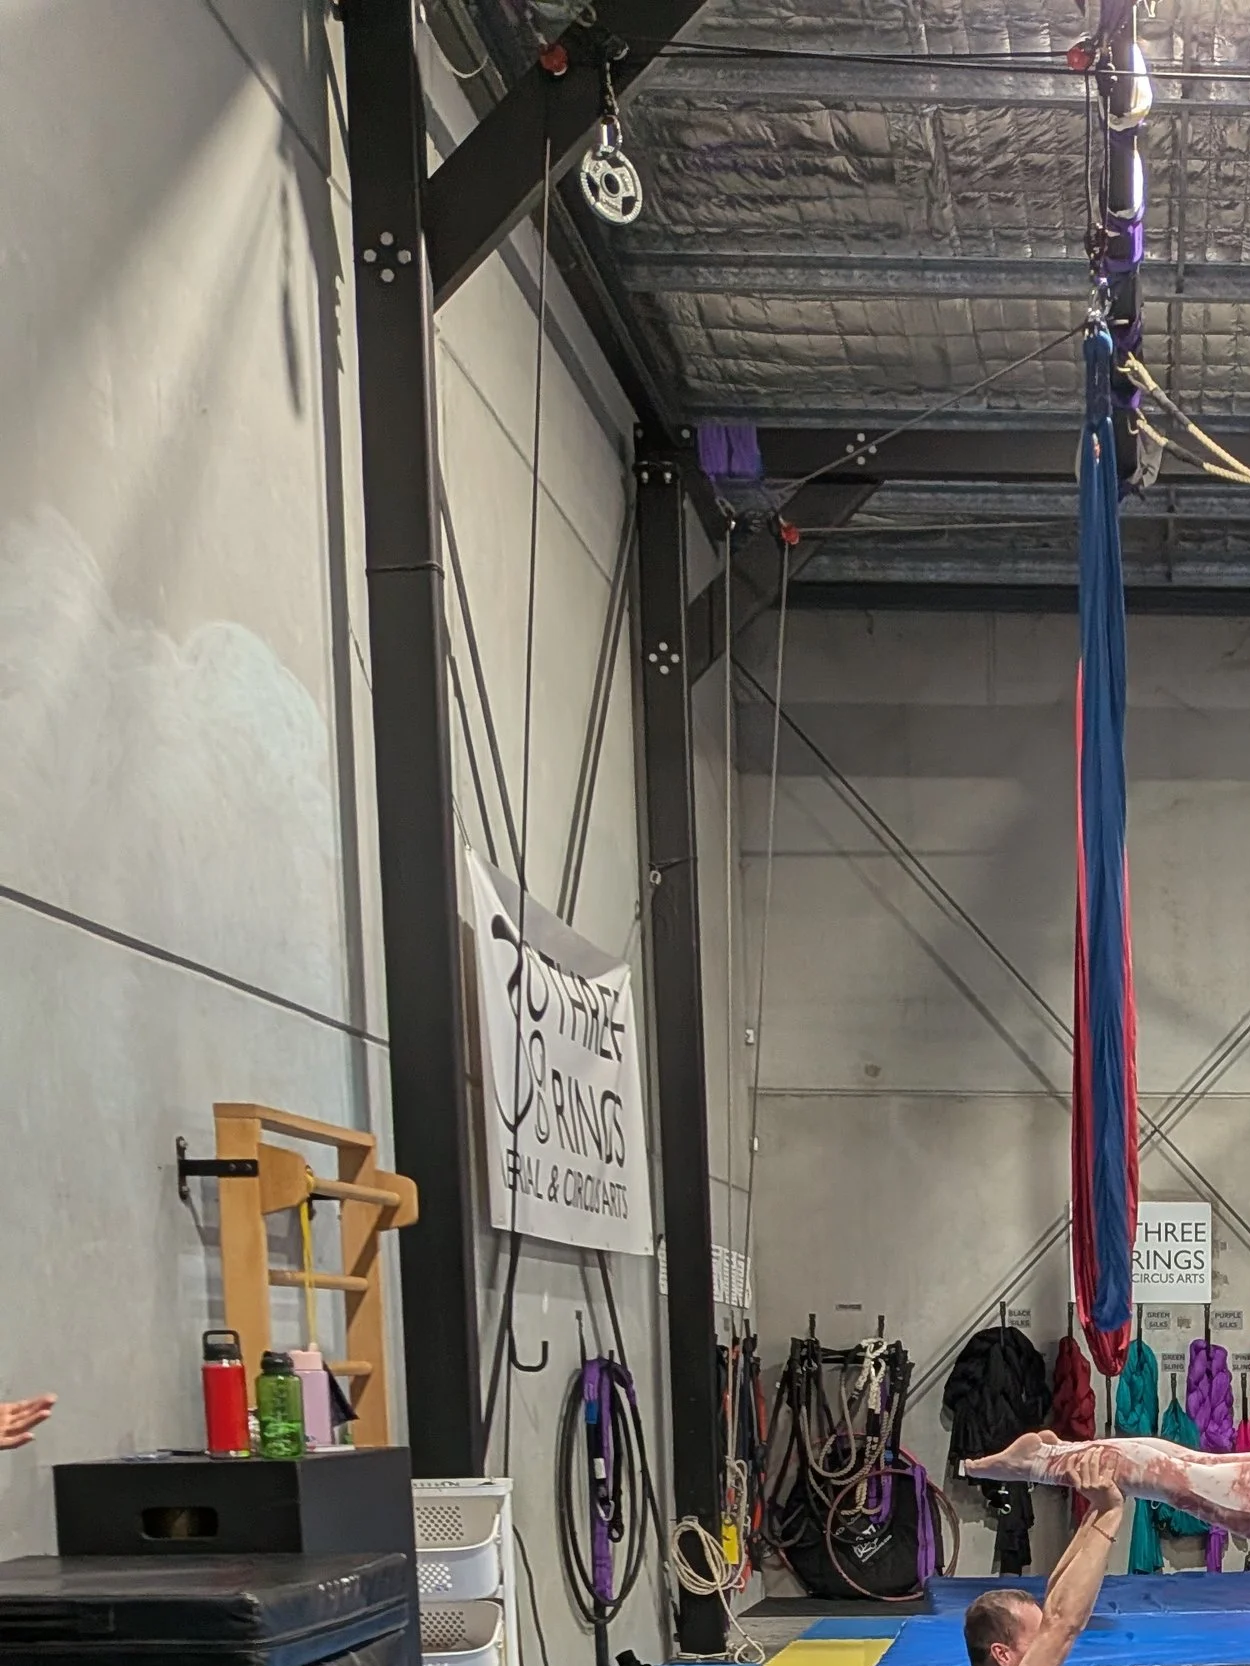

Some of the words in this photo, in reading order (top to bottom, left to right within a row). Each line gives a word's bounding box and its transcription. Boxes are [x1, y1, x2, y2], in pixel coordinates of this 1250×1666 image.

[538, 951, 625, 1063] THREE
[551, 1068, 626, 1169] RINGS
[547, 1164, 559, 1203] &
[601, 1180, 629, 1220] ARTS
[1131, 1250, 1205, 1270] RINGS
[1131, 1273, 1174, 1284] CIRCUS
[1176, 1273, 1205, 1284] ARTS
[1008, 1309, 1031, 1317] BLACK
[1162, 1353, 1185, 1361] GREEN
